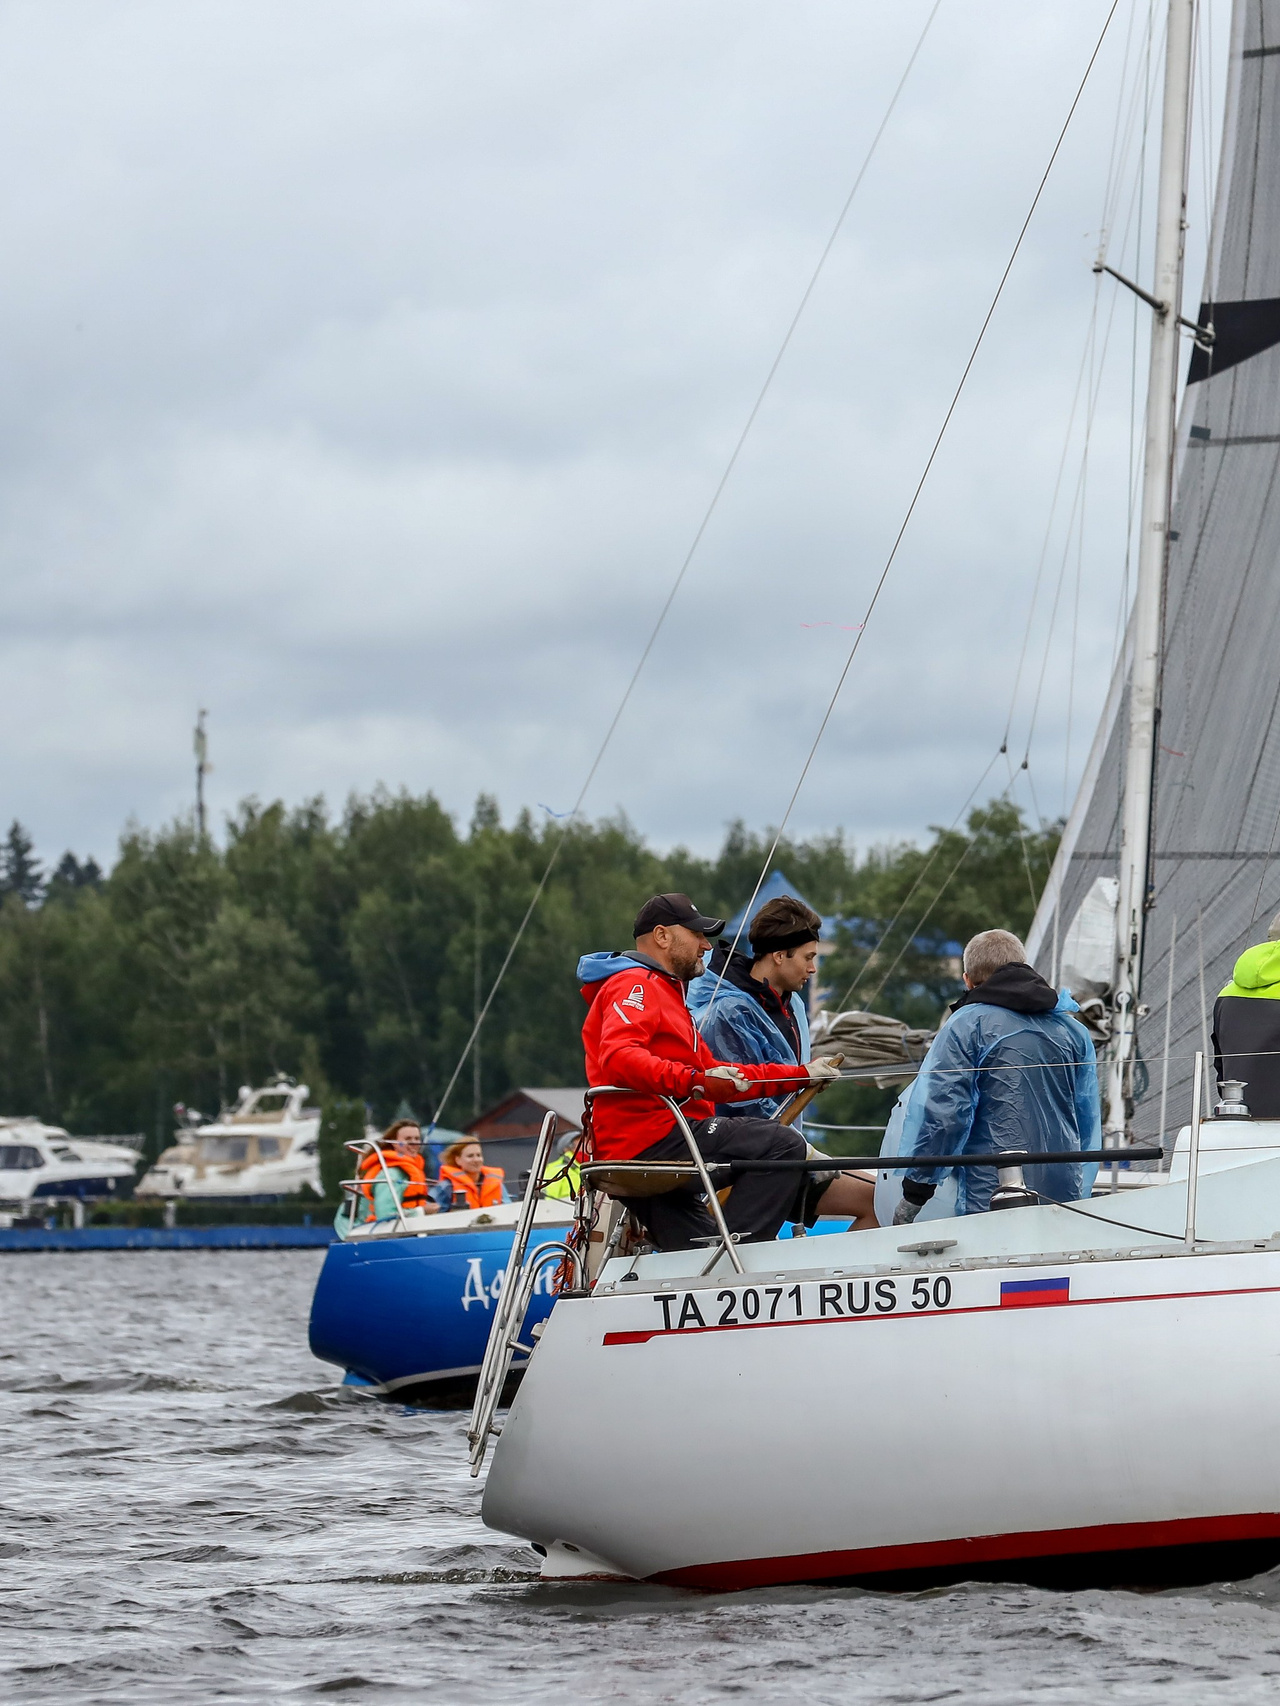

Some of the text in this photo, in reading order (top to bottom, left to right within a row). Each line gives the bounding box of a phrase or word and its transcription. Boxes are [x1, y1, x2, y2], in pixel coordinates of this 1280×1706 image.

[653, 1275, 951, 1330] TA 2071 RUS 50
